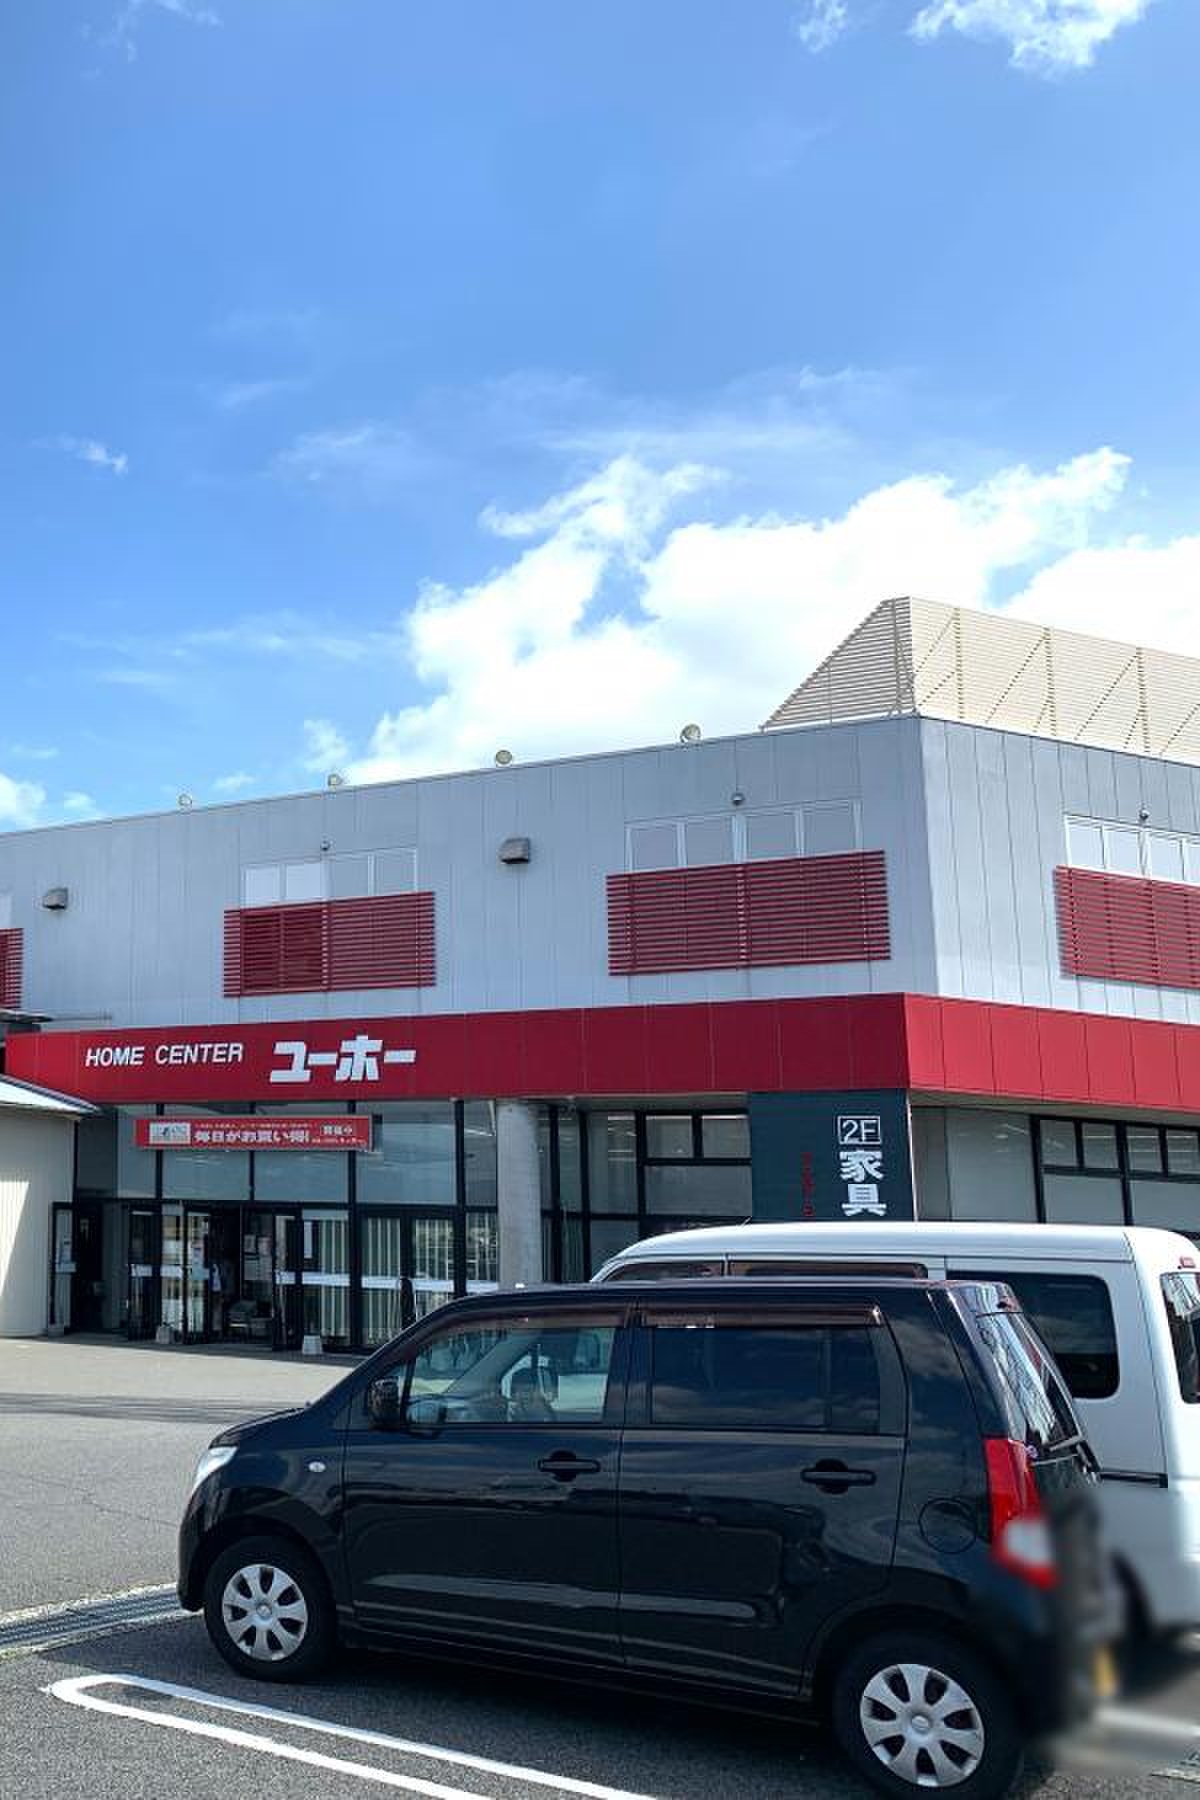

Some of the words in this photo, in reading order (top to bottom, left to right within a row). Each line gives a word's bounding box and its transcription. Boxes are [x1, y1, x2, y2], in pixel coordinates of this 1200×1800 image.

[85, 1046, 145, 1067] HOME
[154, 1043, 243, 1065] CENTER
[270, 1035, 417, 1083] ユーホー
[842, 1119, 877, 1144] 2F
[839, 1149, 887, 1217] 家具
